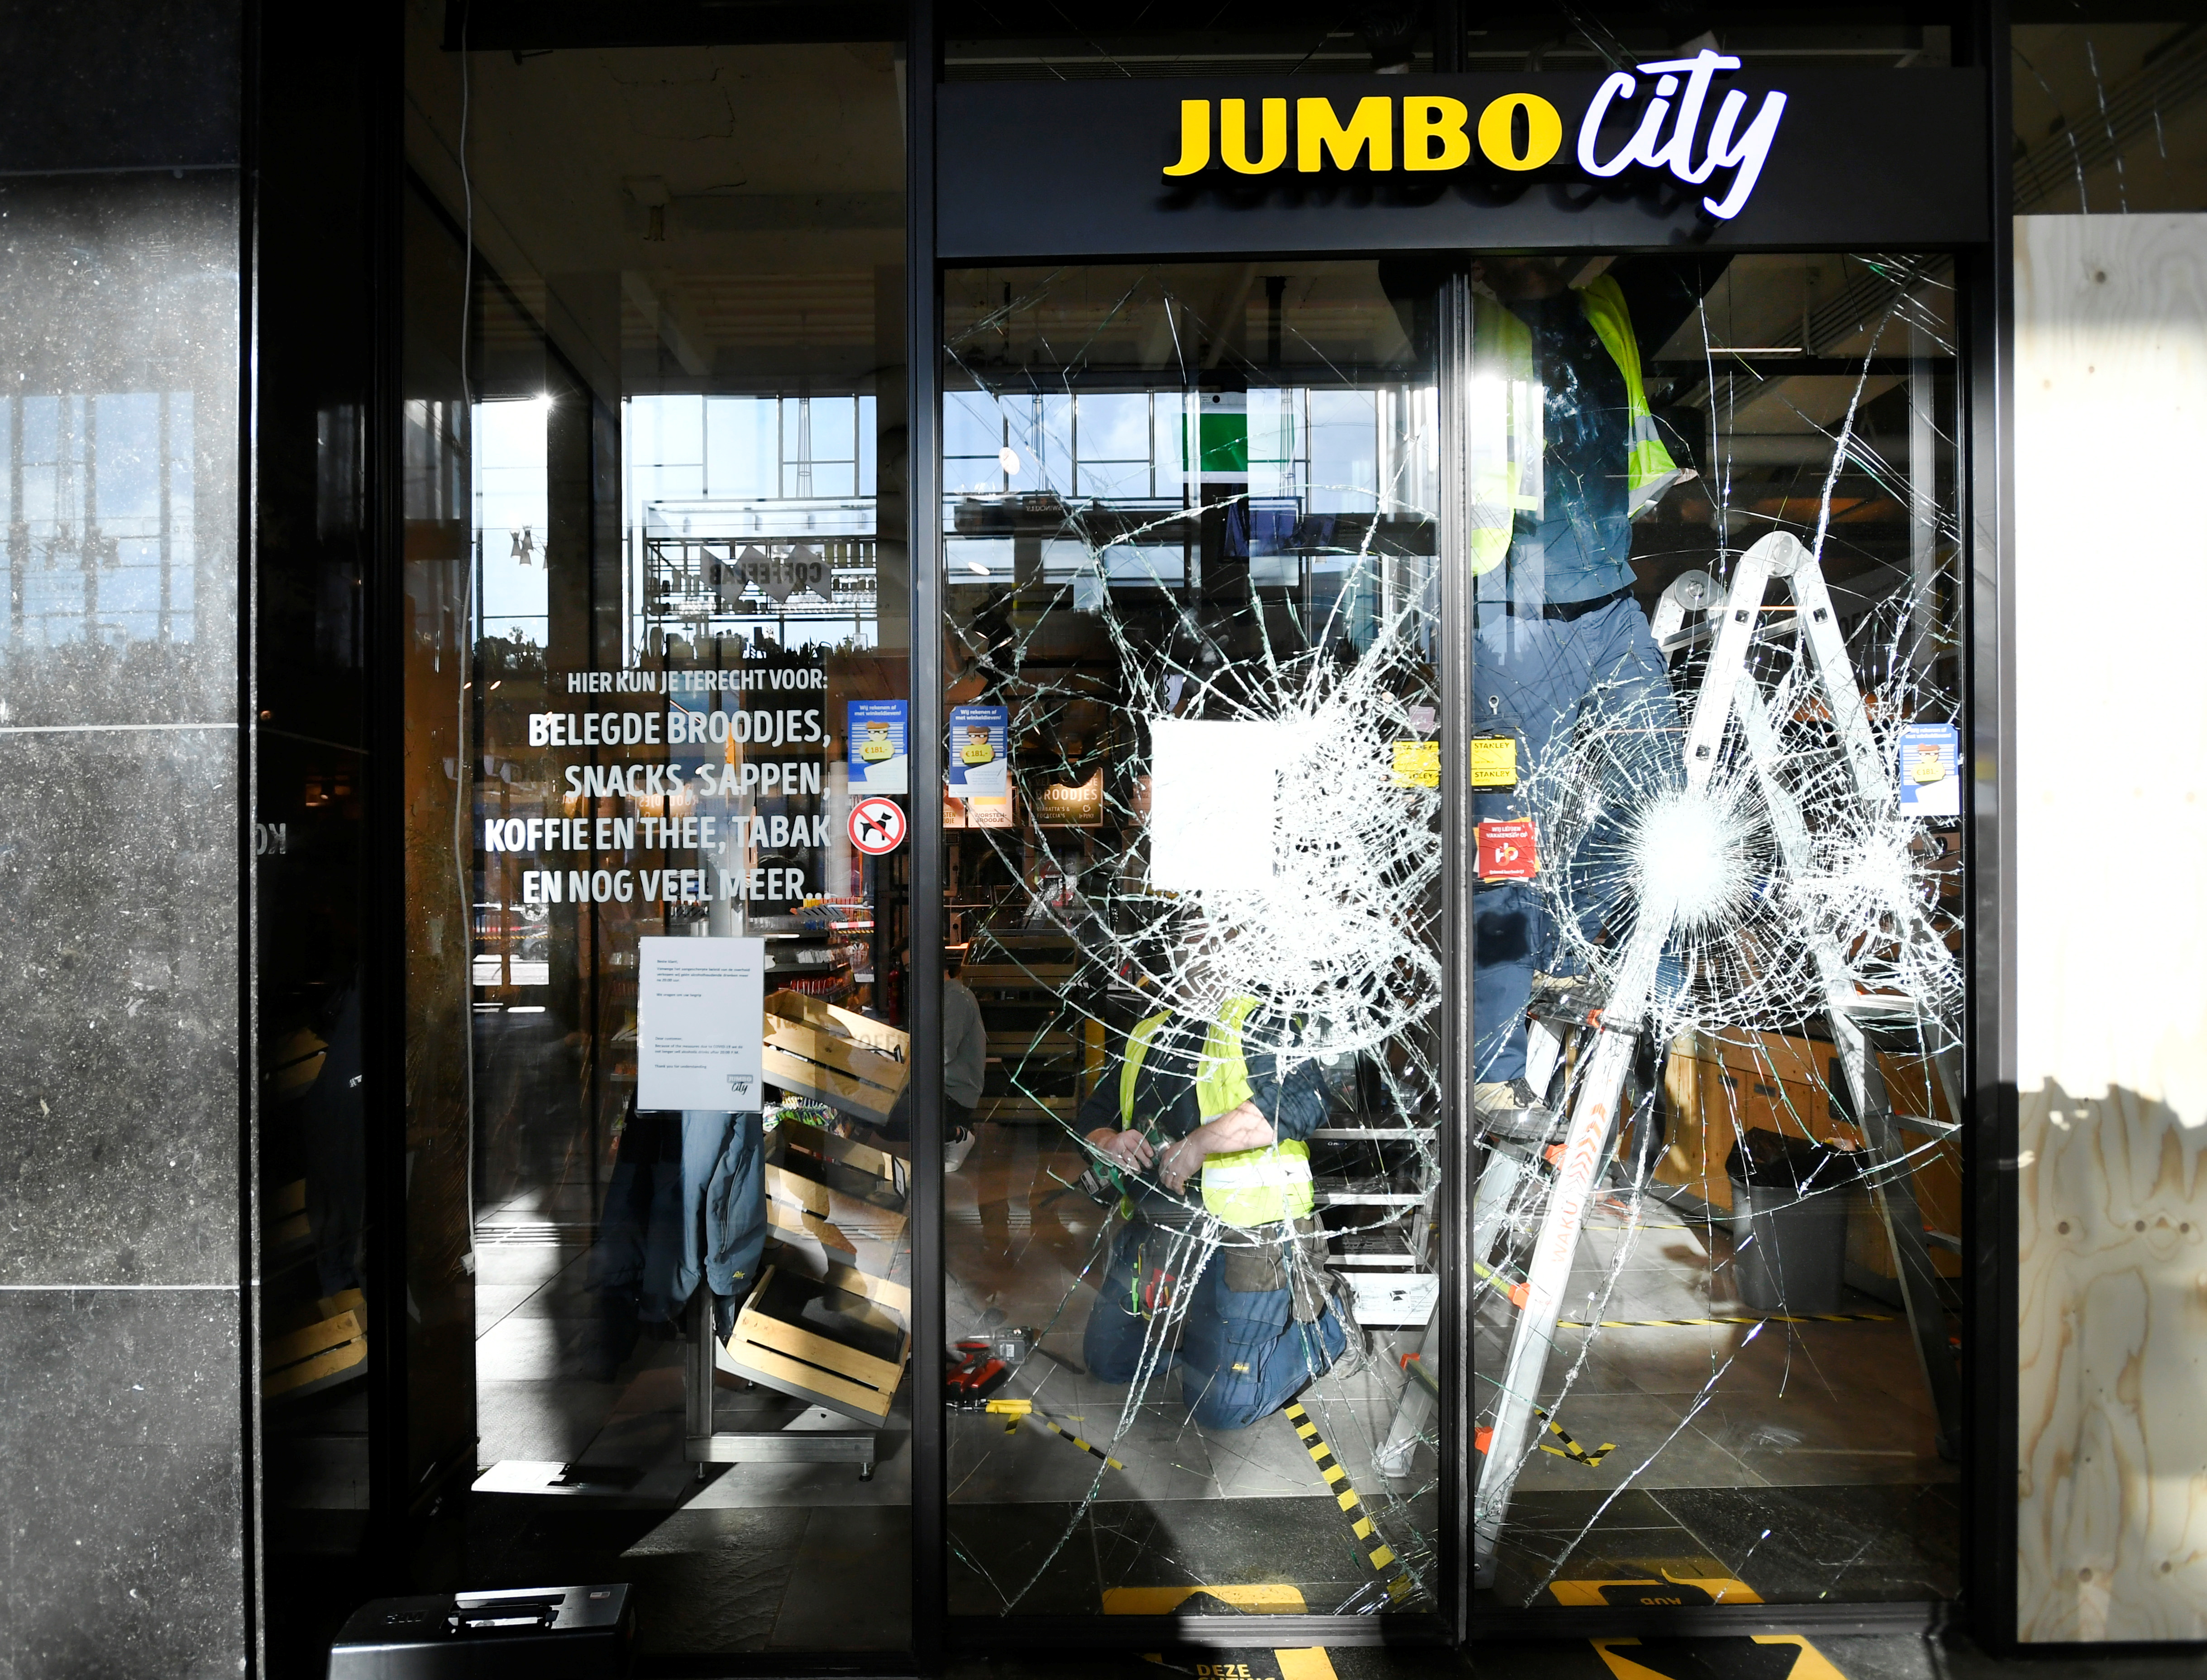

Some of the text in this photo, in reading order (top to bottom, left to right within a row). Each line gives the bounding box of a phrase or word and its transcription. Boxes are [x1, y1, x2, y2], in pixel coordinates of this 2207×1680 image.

[1163, 49, 1787, 219] JUMBO City
[568, 668, 828, 695] HIER KUN JE TERECHT VOOR:
[529, 709, 830, 749] BELEGDE BROODJES,
[564, 762, 830, 802] SNACKS, SAPPEN,
[1036, 789, 1098, 801] BROODJES
[485, 815, 831, 854] KOFFIE EN THEE, TABAK
[523, 868, 830, 904] EN NOG VEEL MEER...
[1552, 1202, 1577, 1262] WAKU
[1196, 1664, 1251, 1678] DEZE
